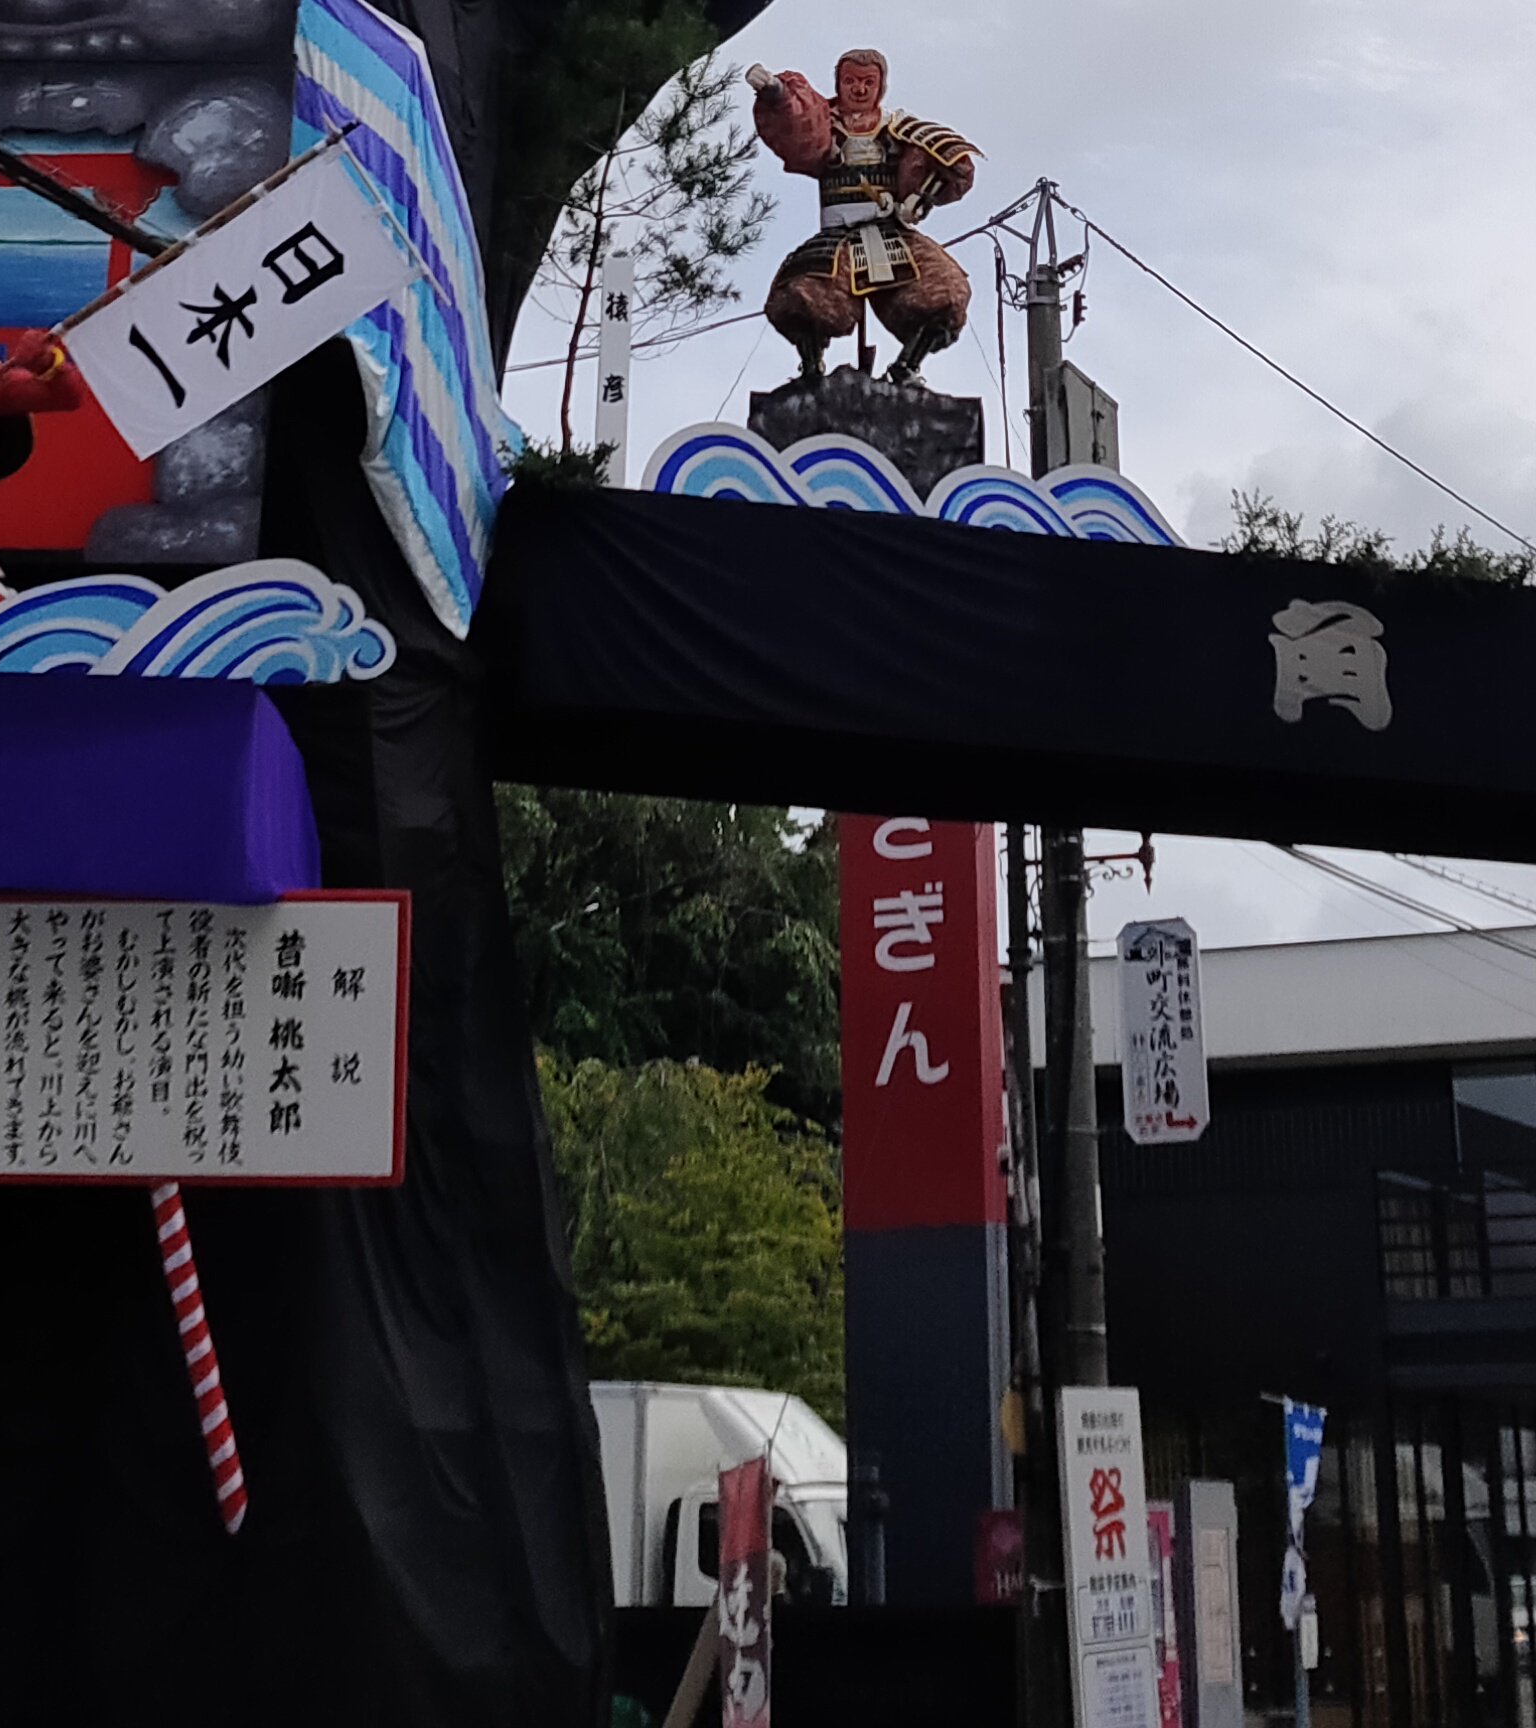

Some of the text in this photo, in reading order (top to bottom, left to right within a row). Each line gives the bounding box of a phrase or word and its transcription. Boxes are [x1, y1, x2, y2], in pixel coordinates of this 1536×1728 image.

[128, 221, 345, 408] 日本一
[602, 290, 630, 403] 猿彦
[268, 1016, 305, 1137] 桃太郎
[1088, 1467, 1128, 1561] 祭
